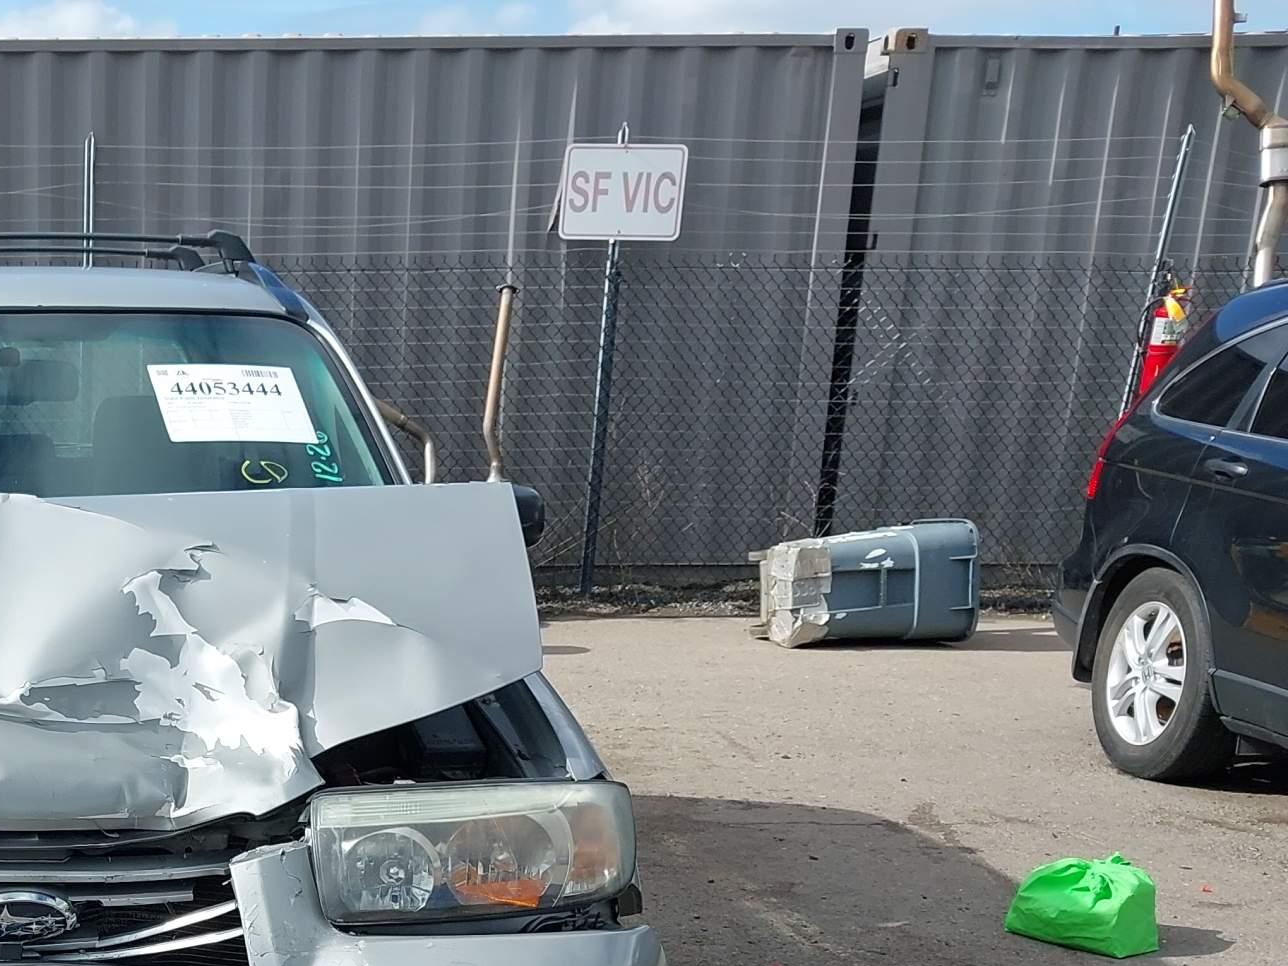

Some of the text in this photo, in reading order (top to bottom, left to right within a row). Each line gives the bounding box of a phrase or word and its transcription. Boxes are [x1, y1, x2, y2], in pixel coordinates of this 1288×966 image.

[568, 170, 677, 214] SF VIC
[170, 381, 282, 397] 44053444
